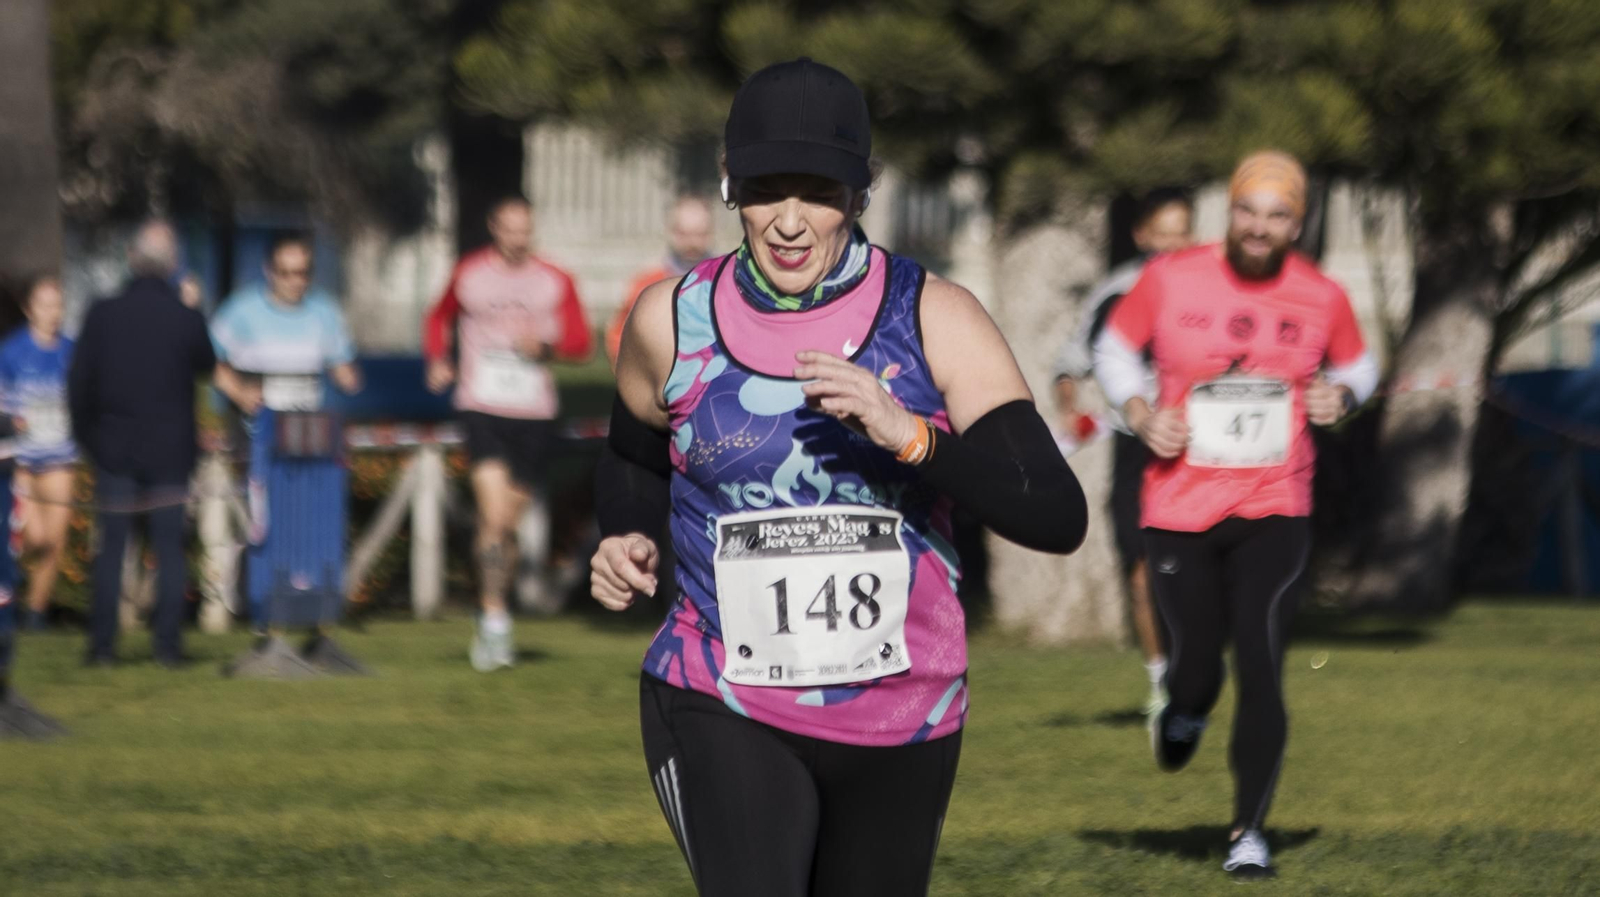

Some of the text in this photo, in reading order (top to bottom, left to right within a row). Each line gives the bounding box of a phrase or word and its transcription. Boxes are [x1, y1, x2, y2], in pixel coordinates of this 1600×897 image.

[1224, 410, 1267, 442] 47
[718, 482, 773, 508] YO
[759, 517, 893, 538] Reyes Mags
[761, 535, 809, 549] Jerez
[767, 573, 882, 636] 148
